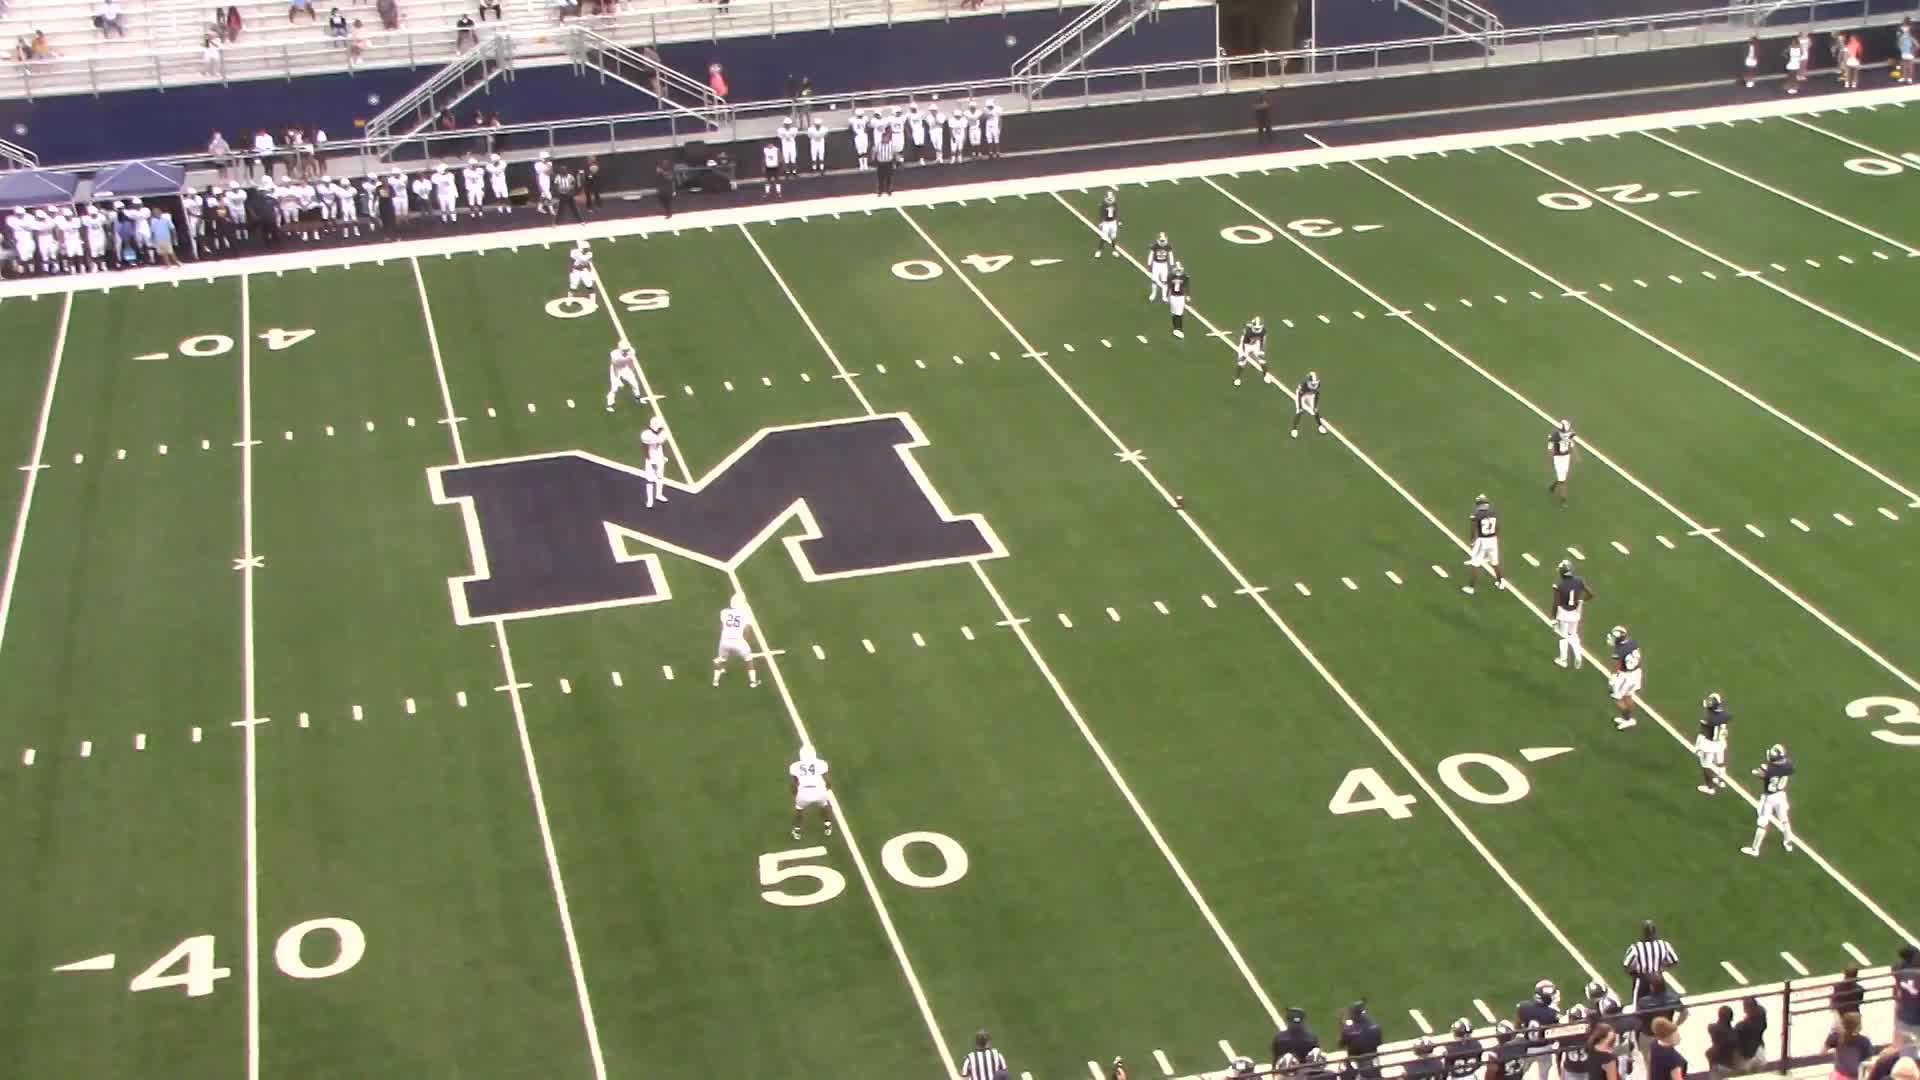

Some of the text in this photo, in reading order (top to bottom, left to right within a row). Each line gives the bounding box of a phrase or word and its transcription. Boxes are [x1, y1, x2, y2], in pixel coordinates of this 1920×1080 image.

[1537, 183, 1660, 210] 20
[1220, 218, 1344, 244] 30
[891, 253, 1014, 280] 40
[178, 328, 316, 357] 40
[426, 411, 1010, 626] M
[1567, 589, 1575, 606] 1
[726, 613, 742, 628] 26
[799, 763, 816, 776] 54
[1328, 753, 1530, 820] 40
[758, 831, 969, 906] 50
[129, 917, 366, 997] 40
